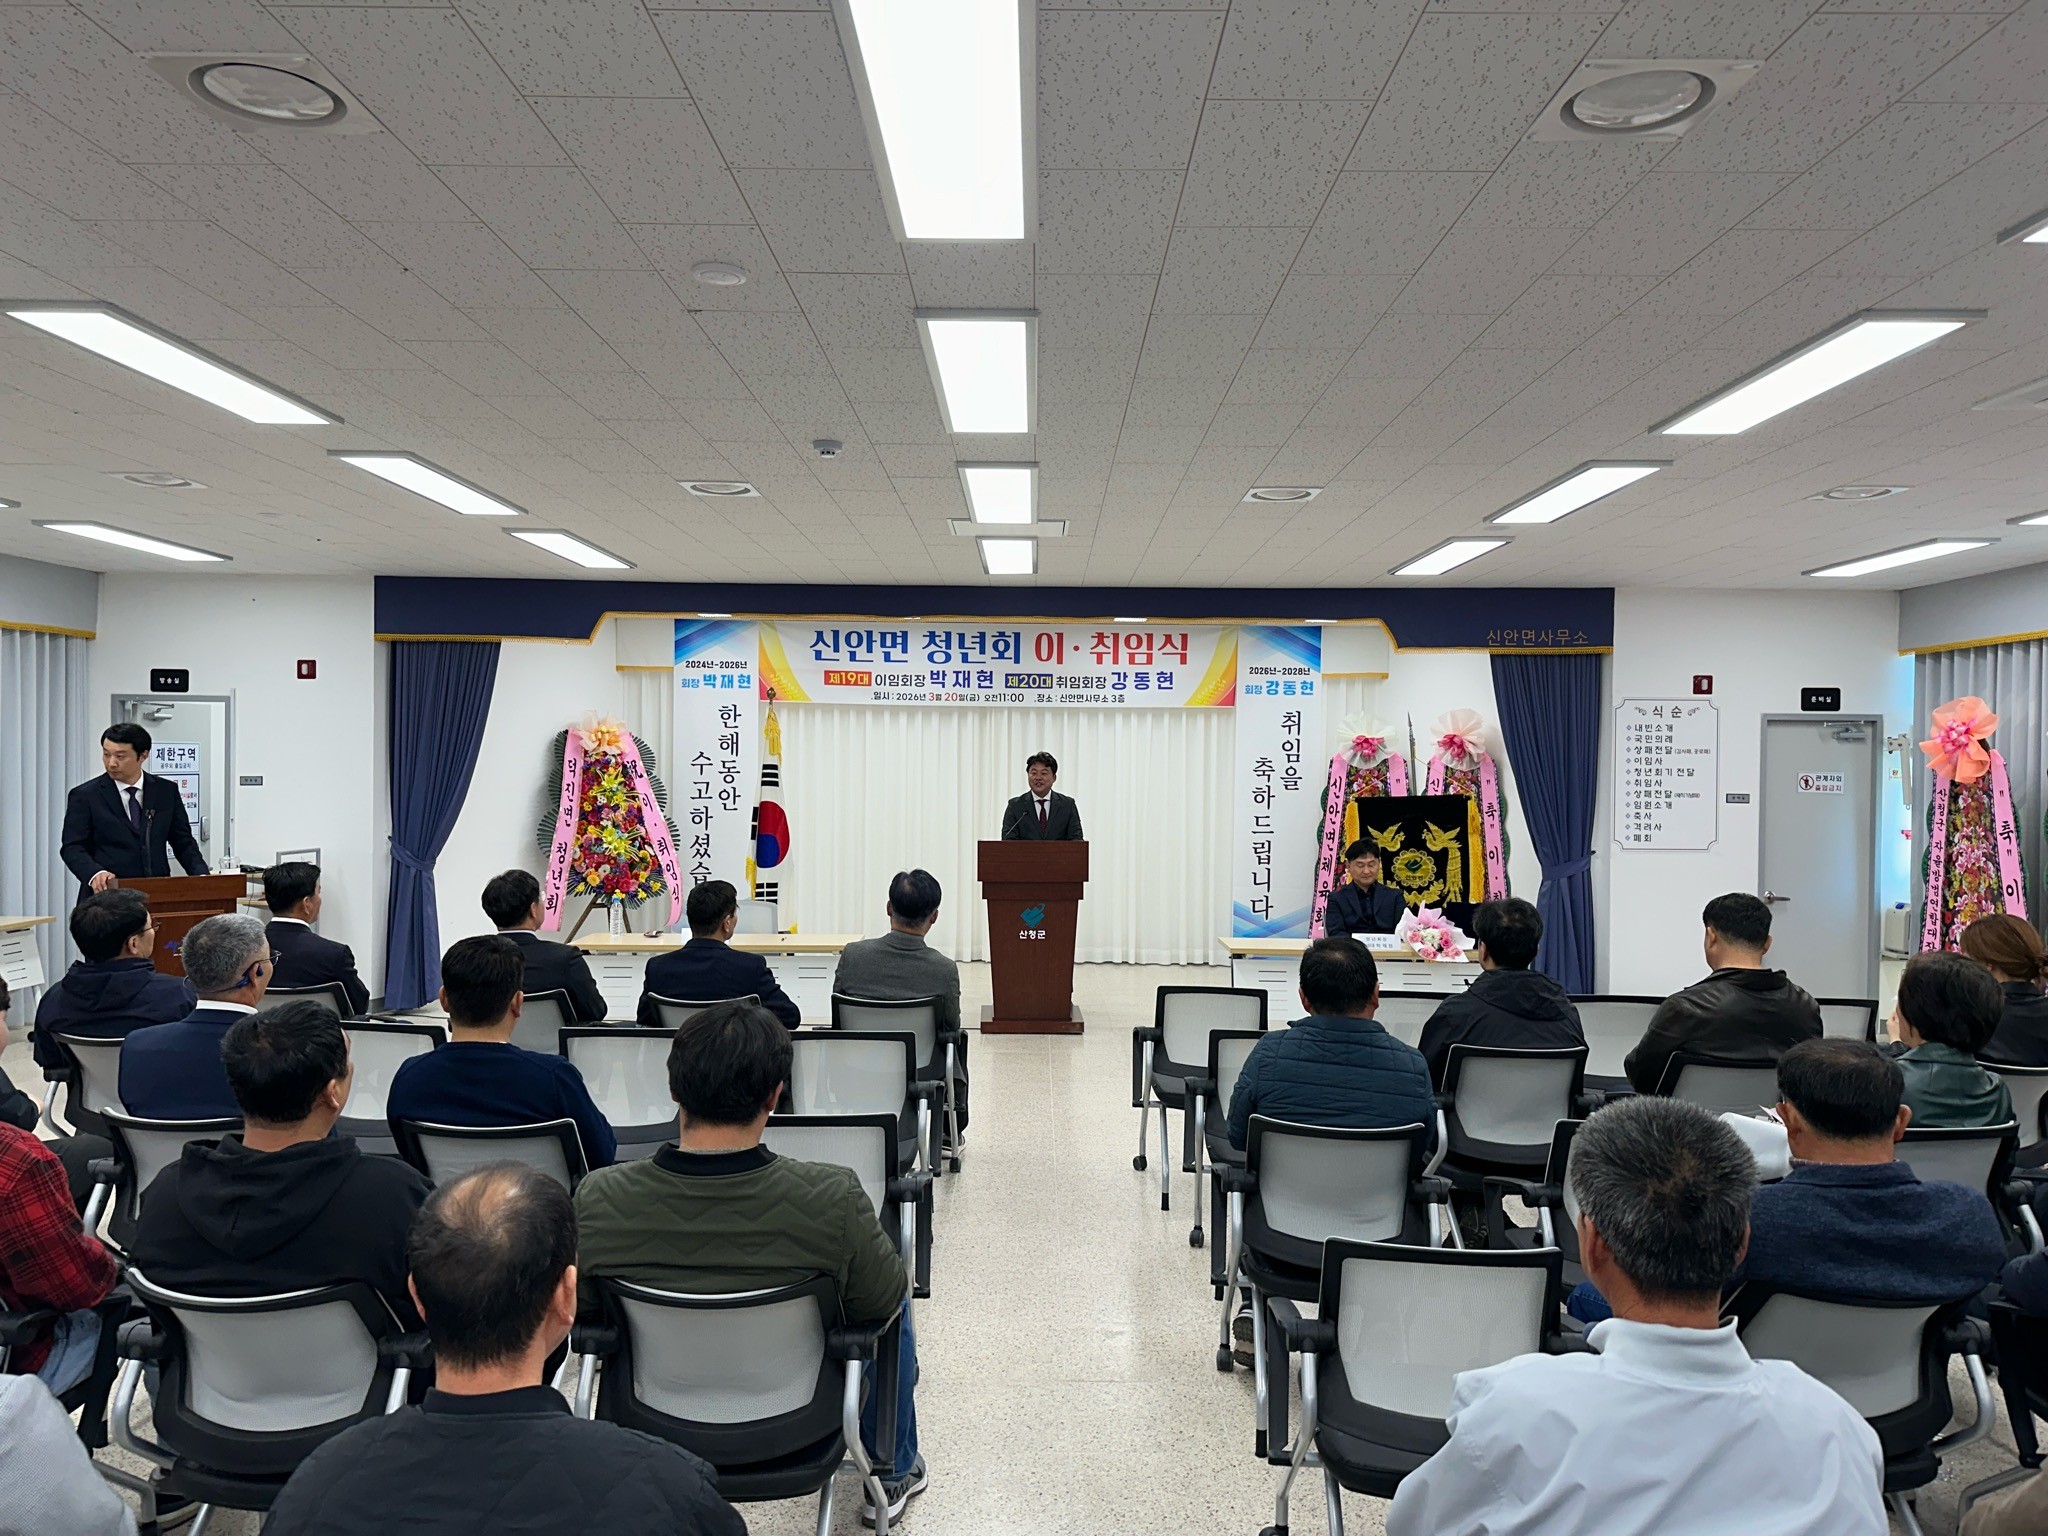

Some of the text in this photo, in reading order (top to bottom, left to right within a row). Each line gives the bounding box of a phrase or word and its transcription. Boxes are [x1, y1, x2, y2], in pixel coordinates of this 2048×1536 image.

[1487, 629, 1589, 646] 신안면사무소
[809, 629, 909, 663] 신안면
[922, 630, 1021, 664] 청년회
[685, 660, 748, 669] 2024년-2026년
[1249, 666, 1311, 676] 2026년-2028년
[681, 678, 700, 688] 회장
[828, 672, 869, 686] 제19대
[875, 674, 926, 688] 이임회장
[1007, 674, 1052, 688] 제20대
[1056, 676, 1107, 689] 취임회장
[1245, 684, 1263, 695] 회장
[896, 693, 926, 701] 2026년
[929, 693, 942, 701] 3월
[945, 693, 980, 702] 20일(금)
[1059, 694, 1109, 703] 신안면사무소
[1111, 694, 1125, 703] 3층
[1634, 724, 1673, 732] 내빈소개
[1634, 735, 1673, 743] 국민의례
[156, 747, 196, 761] 제한구역
[1280, 711, 1303, 791] 취임을
[1634, 746, 1673, 754] 상패전달
[718, 704, 742, 811] 한해동안
[1634, 757, 1662, 765] 이임사
[1634, 768, 1695, 777] 청년회기 전달
[1634, 779, 1662, 787] 취임사
[1634, 790, 1673, 798] 상패전달
[1634, 801, 1673, 809] 임원소개
[689, 751, 713, 883] 수고하셨습
[1634, 812, 1652, 820] 축사
[1634, 823, 1662, 831] 격려사
[1250, 757, 1275, 921] 축하드립니다
[545, 841, 568, 915] 청년회
[1019, 930, 1046, 939] 산청군
